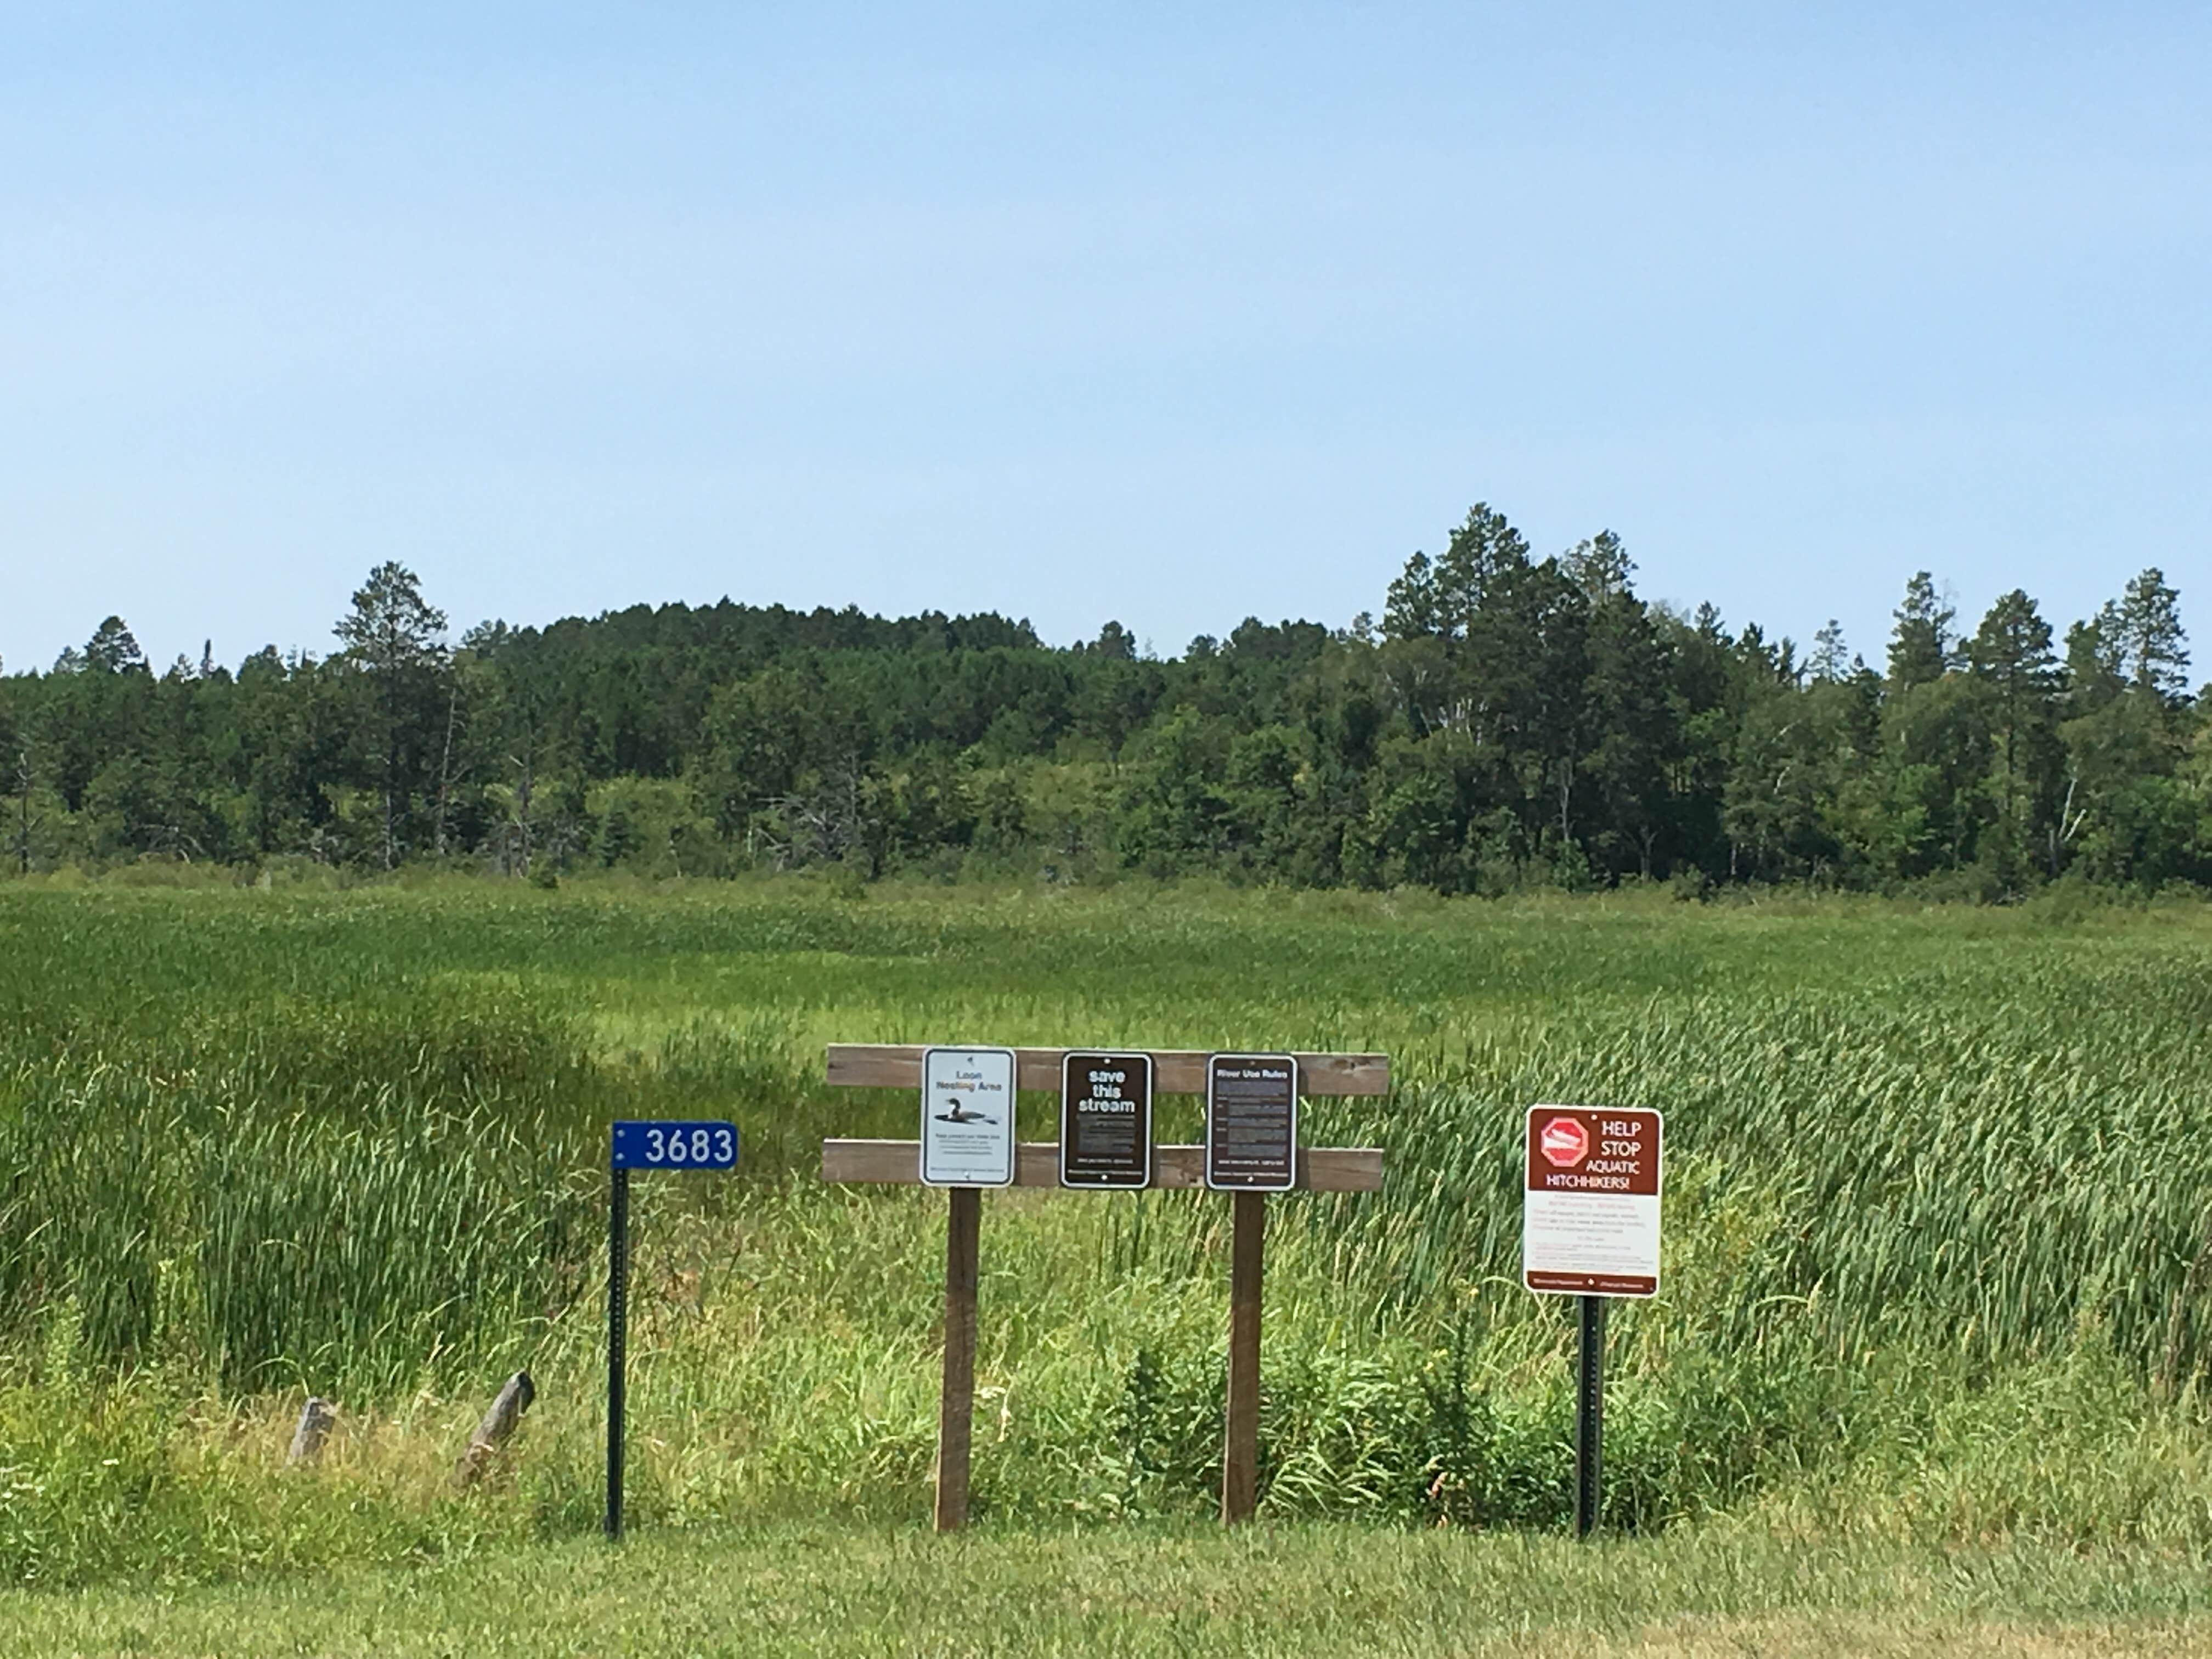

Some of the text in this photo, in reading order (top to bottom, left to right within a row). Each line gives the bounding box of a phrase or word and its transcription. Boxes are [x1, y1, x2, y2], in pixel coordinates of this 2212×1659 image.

[956, 1071, 982, 1079] Loon
[1088, 1071, 1126, 1083] save
[1217, 1069, 1288, 1079] River Use Rules
[936, 1081, 1002, 1092] Nesting Area
[1093, 1085, 1121, 1098] this
[1079, 1098, 1136, 1113] stream
[1601, 1121, 1641, 1137] HELP
[645, 1129, 733, 1163] 3683
[1601, 1141, 1641, 1156] STOP
[1586, 1160, 1640, 1175] AQUATIC
[1546, 1174, 1630, 1189] HITCHHIKERS!
